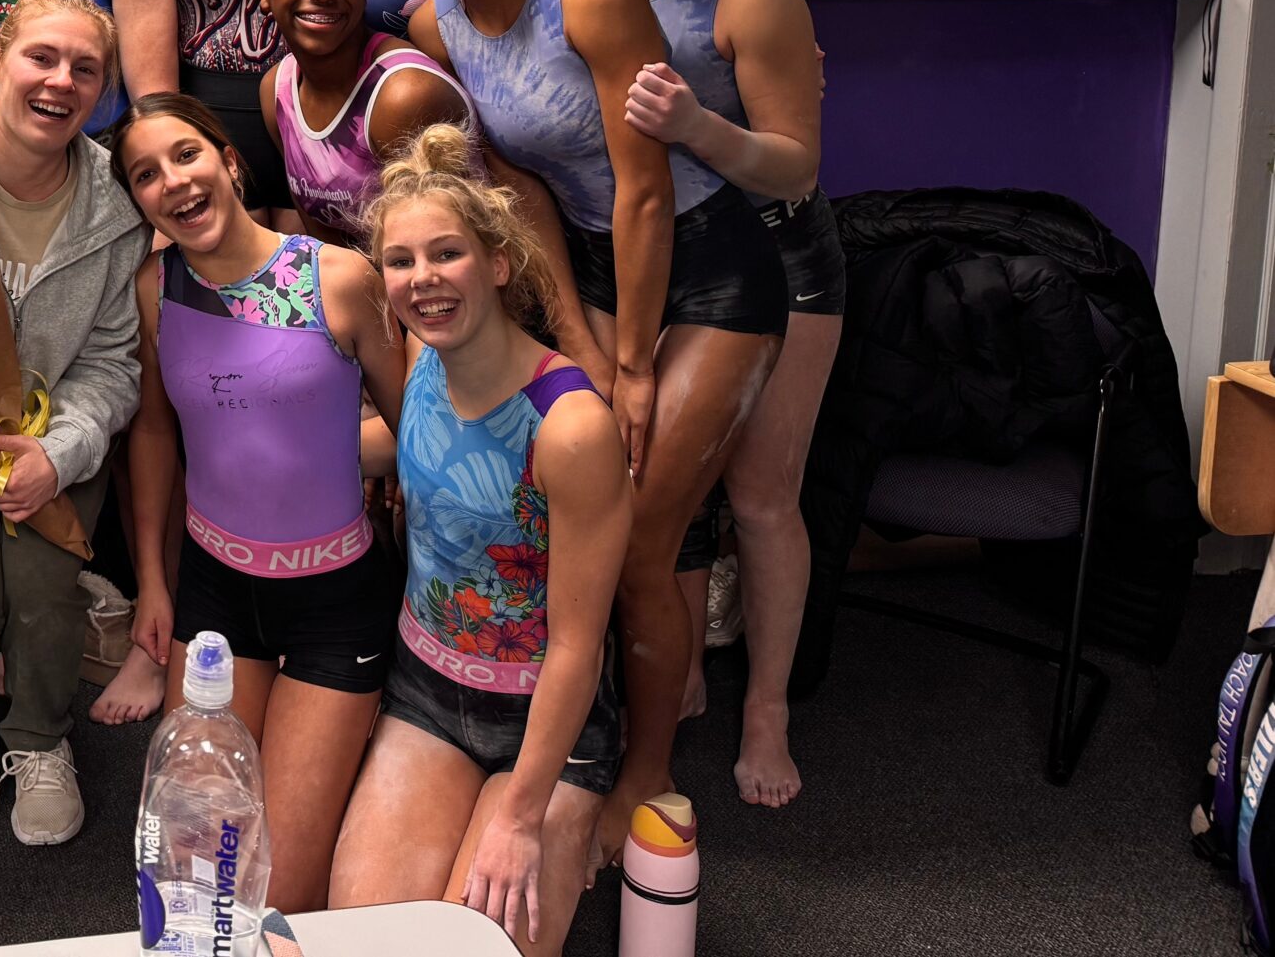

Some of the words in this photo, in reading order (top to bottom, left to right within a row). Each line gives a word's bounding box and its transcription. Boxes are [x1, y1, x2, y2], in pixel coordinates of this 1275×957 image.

[301, 177, 353, 205] Anniversary
[188, 516, 254, 565] PRO
[269, 528, 361, 571] NIKE
[414, 635, 496, 684] PRO
[1224, 652, 1256, 704] OACH
[143, 812, 162, 865] water
[211, 819, 241, 957] martwater
